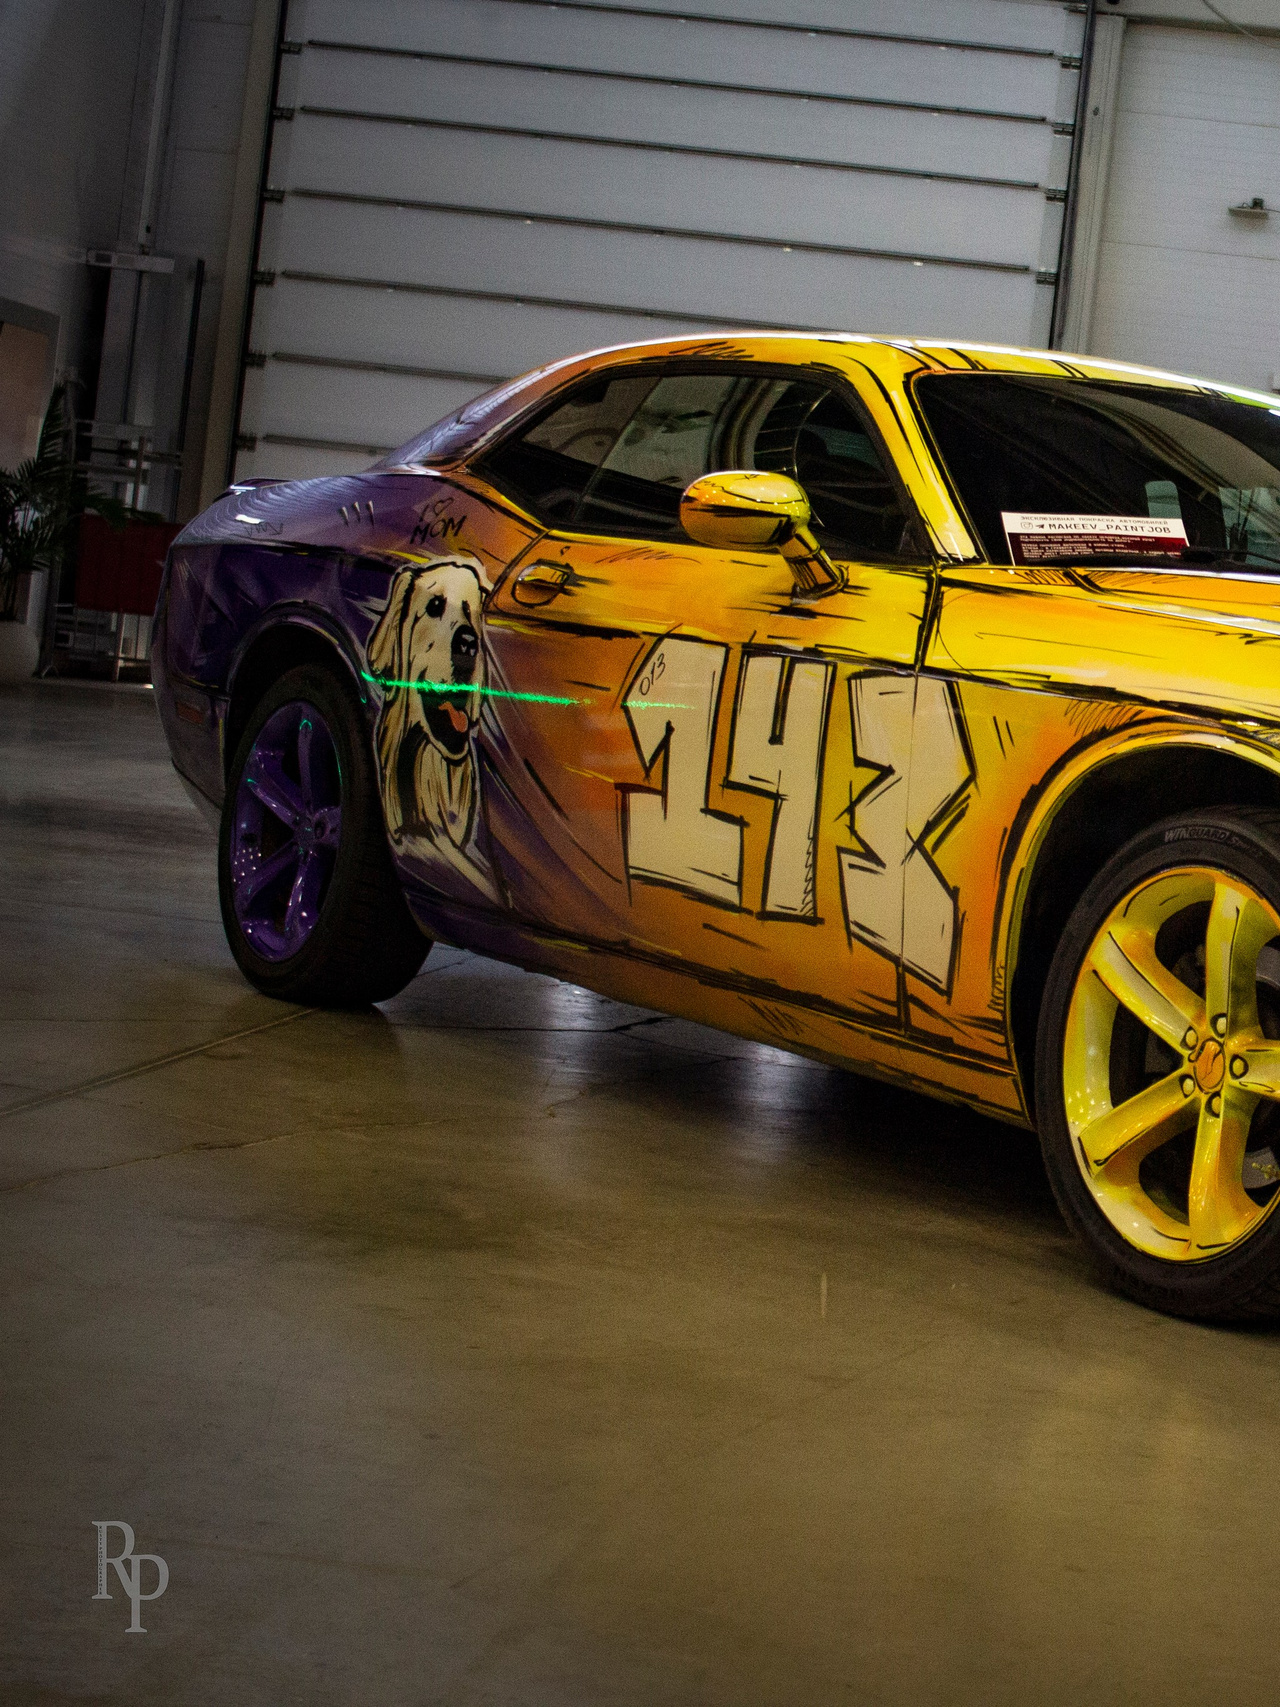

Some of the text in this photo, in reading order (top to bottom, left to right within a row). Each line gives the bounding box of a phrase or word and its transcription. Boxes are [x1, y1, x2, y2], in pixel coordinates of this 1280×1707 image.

[1048, 523, 1172, 534] MAKEEV_PAINTJOB
[1118, 518, 1169, 526] АВТОМОБИЛЕЙ
[409, 515, 467, 544] MOM
[1164, 825, 1229, 843] WINGUARD
